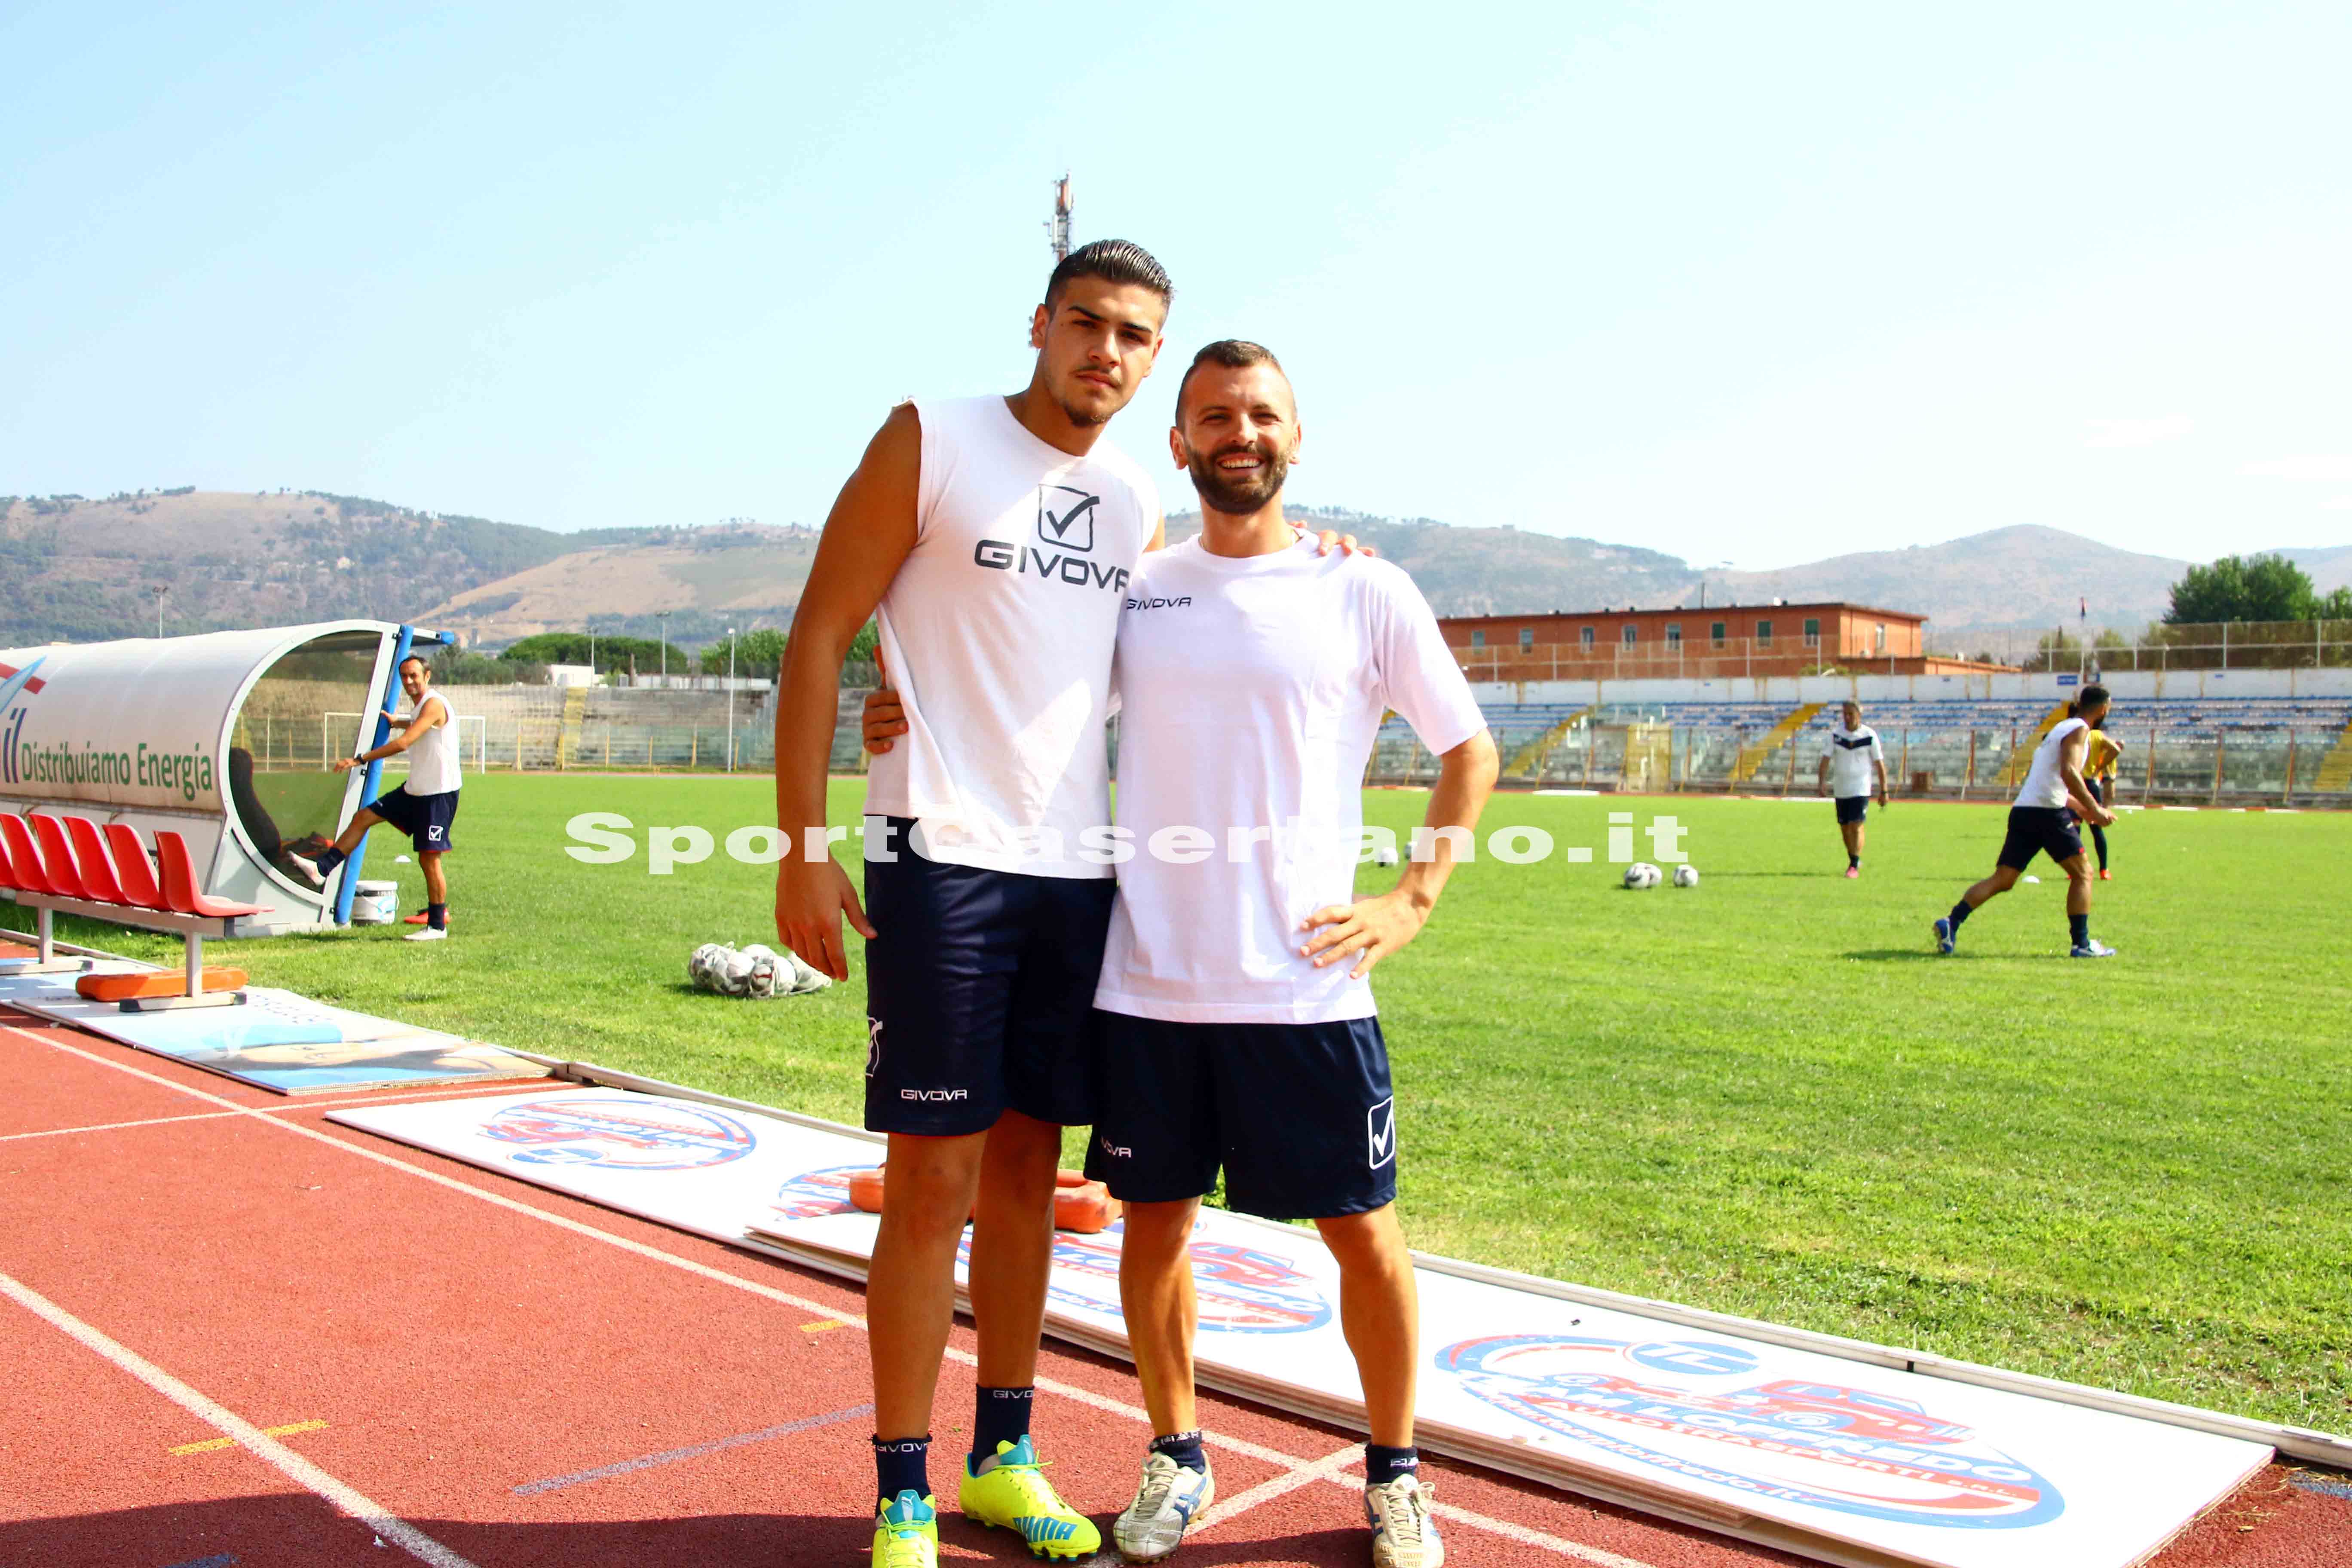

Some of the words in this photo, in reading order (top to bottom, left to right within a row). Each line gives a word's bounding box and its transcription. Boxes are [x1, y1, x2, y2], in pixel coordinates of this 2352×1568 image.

[974, 540, 1130, 593] GIVOVA
[22, 741, 131, 785] Distribuiamo
[138, 742, 213, 802] Energia
[900, 1088, 968, 1101] GIVOVA
[1540, 1401, 1936, 1479] AUTOTRASPORTI
[1635, 1406, 2032, 1481] LOFFREDO
[1012, 1516, 1078, 1544] PUMA
